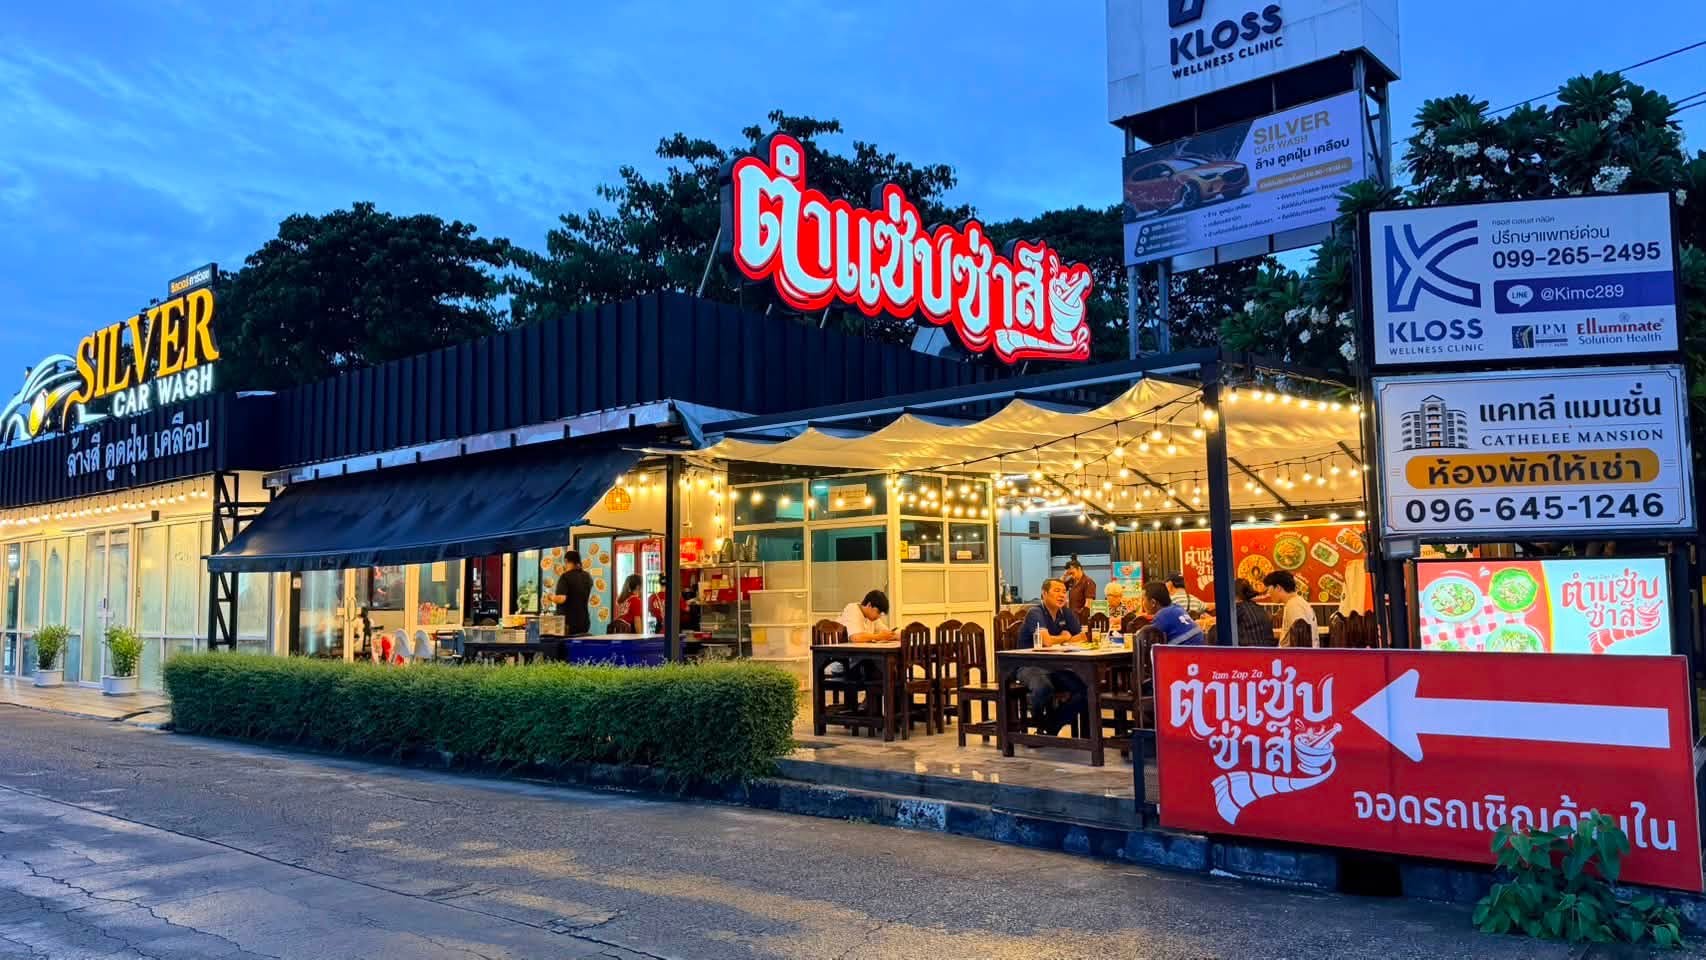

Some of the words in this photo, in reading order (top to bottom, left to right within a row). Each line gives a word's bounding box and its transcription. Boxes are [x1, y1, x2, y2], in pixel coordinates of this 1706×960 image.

[1170, 4, 1282, 66] KLOSS
[1172, 52, 1234, 80] WELLNESS
[1239, 37, 1283, 58] CLINIC
[1253, 110, 1330, 145] SILVER
[1254, 145, 1274, 155] CAR
[1277, 134, 1308, 149] WASH
[1314, 137, 1350, 155] เคลือบ
[1491, 224, 1610, 245] ปรึกษาแพทย์ด่วน
[1492, 242, 1660, 269] 099-265-2495
[1512, 291, 1528, 299] LINE
[1541, 284, 1624, 301] @Kimc289
[1388, 318, 1483, 343] KLOSS
[1578, 335, 1625, 345] Solution
[1627, 333, 1662, 342] Health
[61, 288, 219, 432] SILVER
[1389, 345, 1443, 355] WELLNESS
[1447, 343, 1484, 352] CLINIC
[112, 383, 150, 417] CAR
[157, 363, 213, 405] WASH
[1479, 393, 1555, 422] แคทลี
[1566, 382, 1662, 418] แมนชั่น
[67, 431, 101, 478] ล้างสี
[105, 424, 148, 480] ดูดฝุ่น
[154, 411, 210, 458] เคลือบ
[1482, 432, 1570, 447] CATHELEE
[1577, 428, 1664, 443] MANSION
[1428, 452, 1641, 485] ห้องพักให้เช่า
[1405, 492, 1664, 523] 096-645-1246
[1562, 568, 1658, 611] ตำแซ่บ
[1212, 671, 1229, 679] Tam
[1170, 659, 1333, 737] ตำแซ่บ
